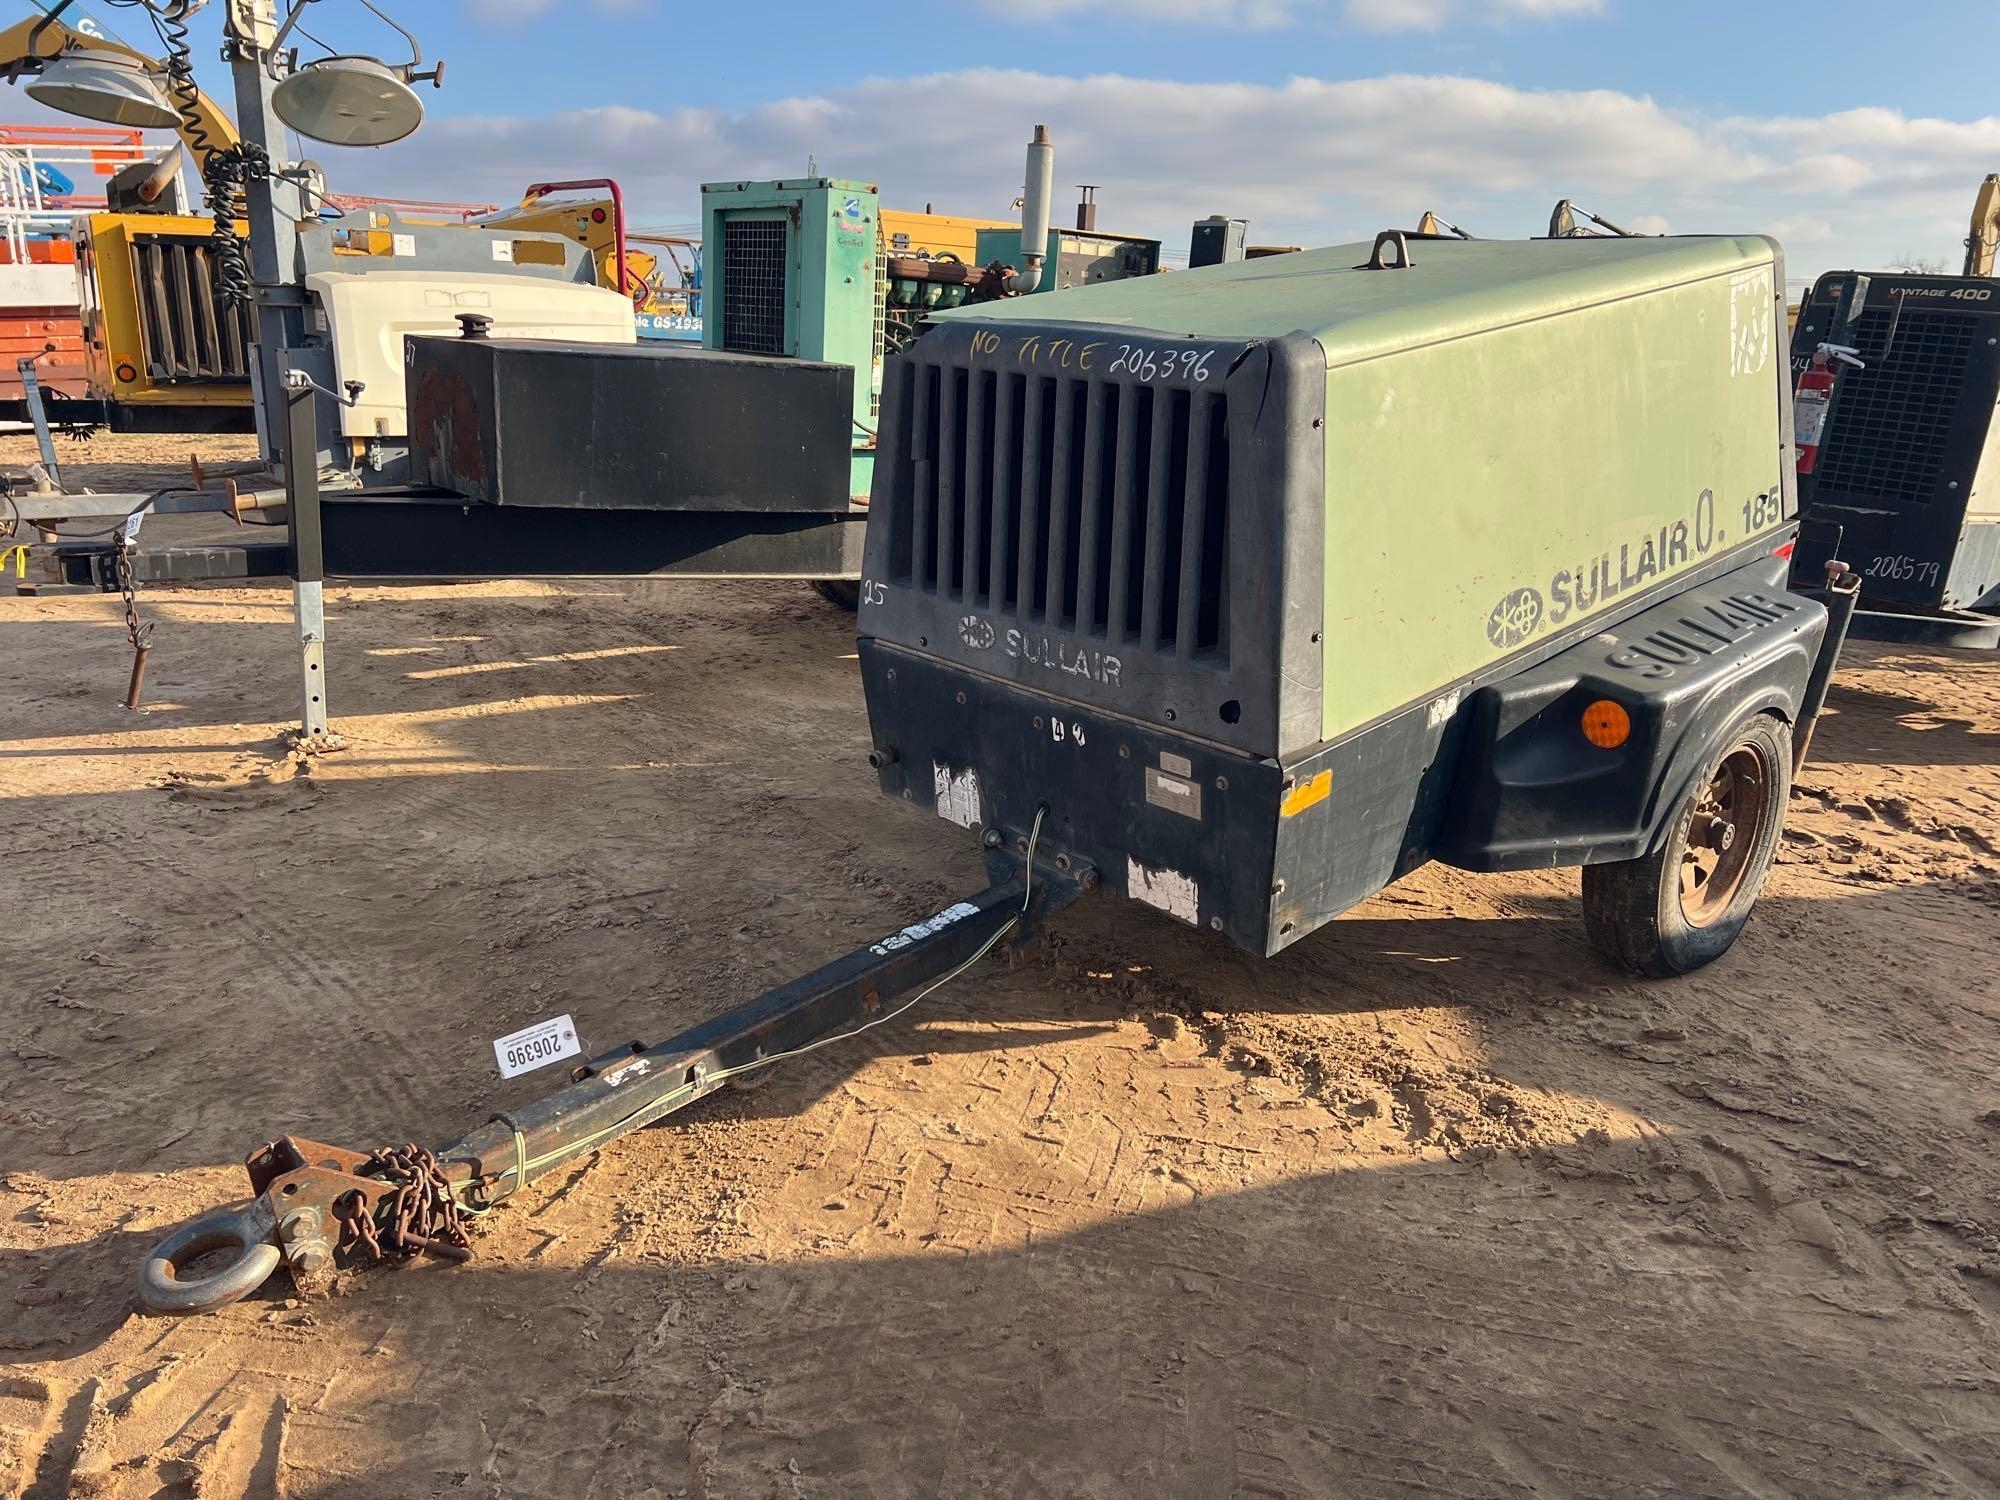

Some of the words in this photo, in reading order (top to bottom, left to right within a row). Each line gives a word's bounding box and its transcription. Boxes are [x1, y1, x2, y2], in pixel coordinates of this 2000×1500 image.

[1950, 288, 1992, 301] 400
[970, 329, 1001, 361] NO
[1109, 344, 1215, 382] 206396
[1549, 519, 1688, 624] SULLAIR
[1742, 485, 1780, 535] 185
[1865, 555, 1941, 588] 206579
[864, 579, 888, 605] 25
[1604, 591, 1801, 679] SULLAIR
[1005, 629, 1123, 688] SULLAIR
[507, 1033, 562, 1068] 206396
